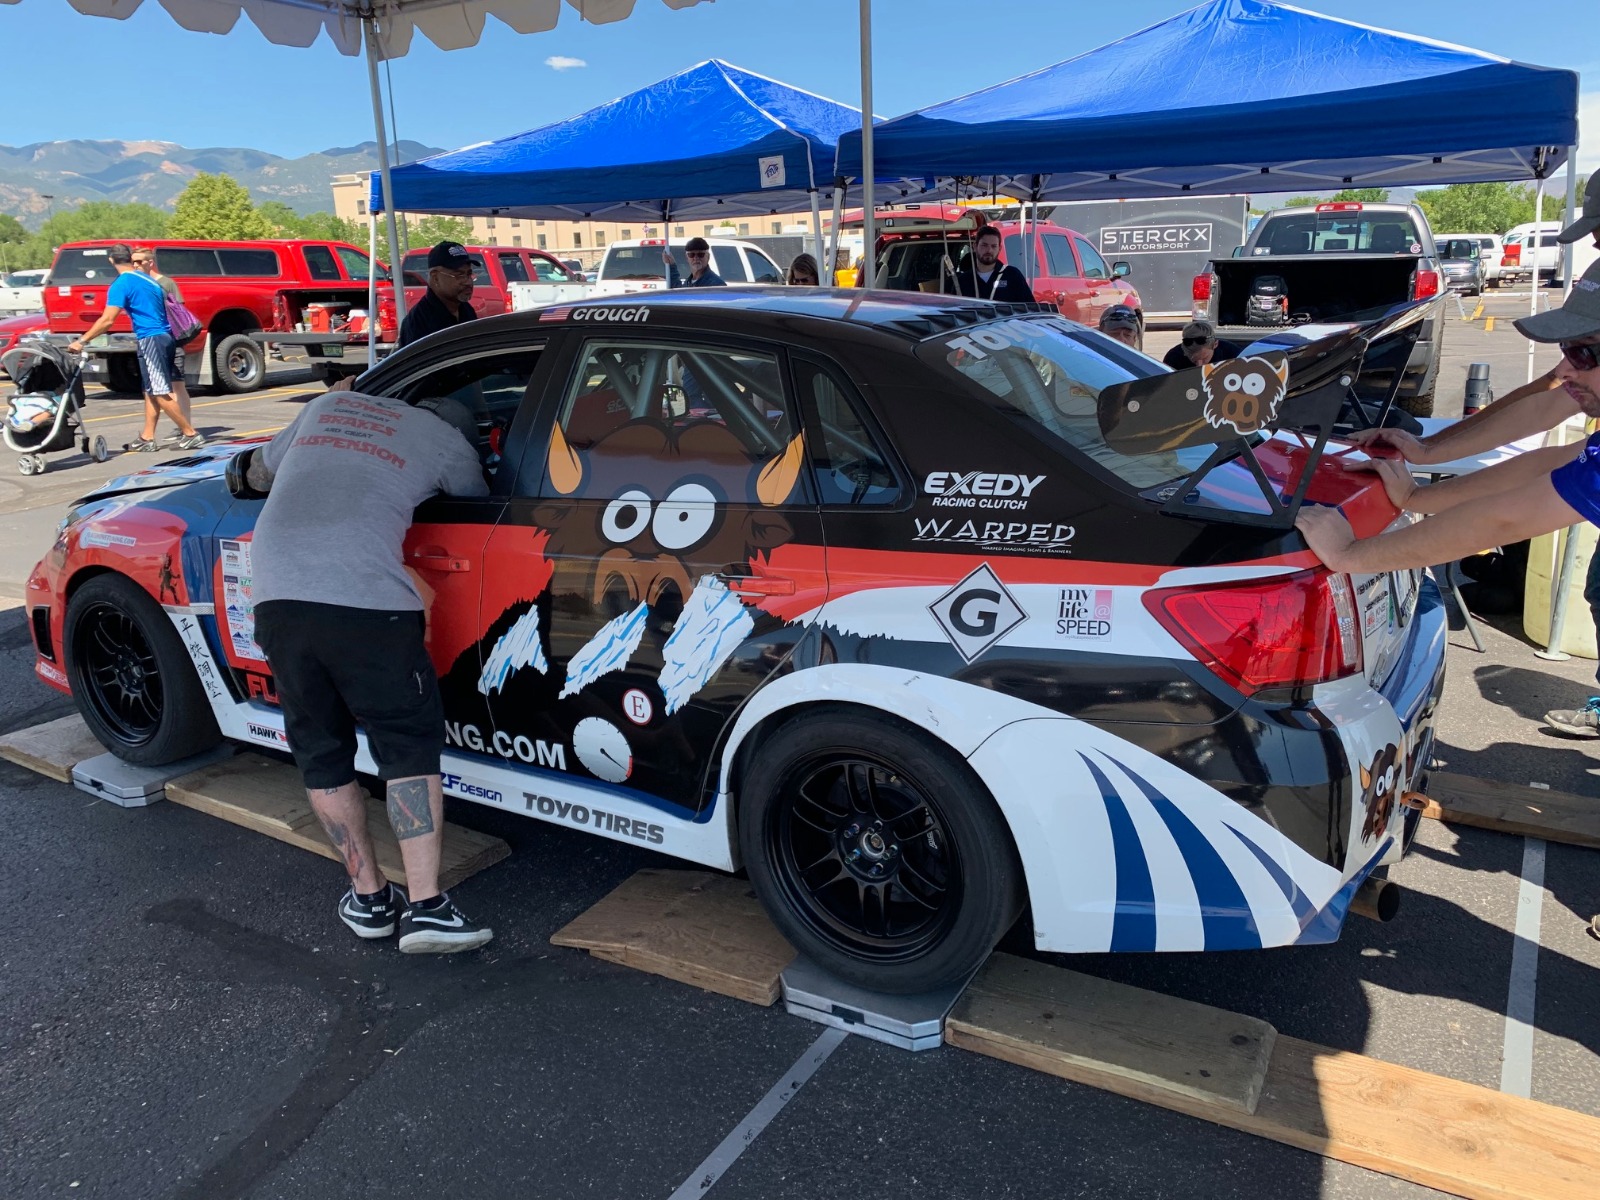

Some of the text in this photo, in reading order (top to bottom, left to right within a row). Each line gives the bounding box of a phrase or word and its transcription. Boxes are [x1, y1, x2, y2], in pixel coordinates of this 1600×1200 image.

[1103, 228, 1208, 245] STERCKX
[1120, 242, 1190, 251] MOTORSPORT
[572, 305, 651, 322] crouch
[945, 319, 1047, 360] TOYO
[335, 397, 402, 419] POWER
[318, 413, 397, 437] BRAKES
[345, 430, 374, 439] GREAT
[292, 435, 406, 469] SUSPENSION
[924, 470, 1048, 498] EXEDY
[932, 497, 1028, 510] RACING CLUTCH
[913, 517, 1077, 543] WARPED
[1060, 588, 1092, 606] my
[949, 588, 1002, 638] G
[1059, 601, 1089, 619] life
[1056, 619, 1111, 636] SPEED
[631, 695, 645, 719] E
[249, 724, 278, 741] HAWK
[522, 792, 665, 845] TOYO TIRES
